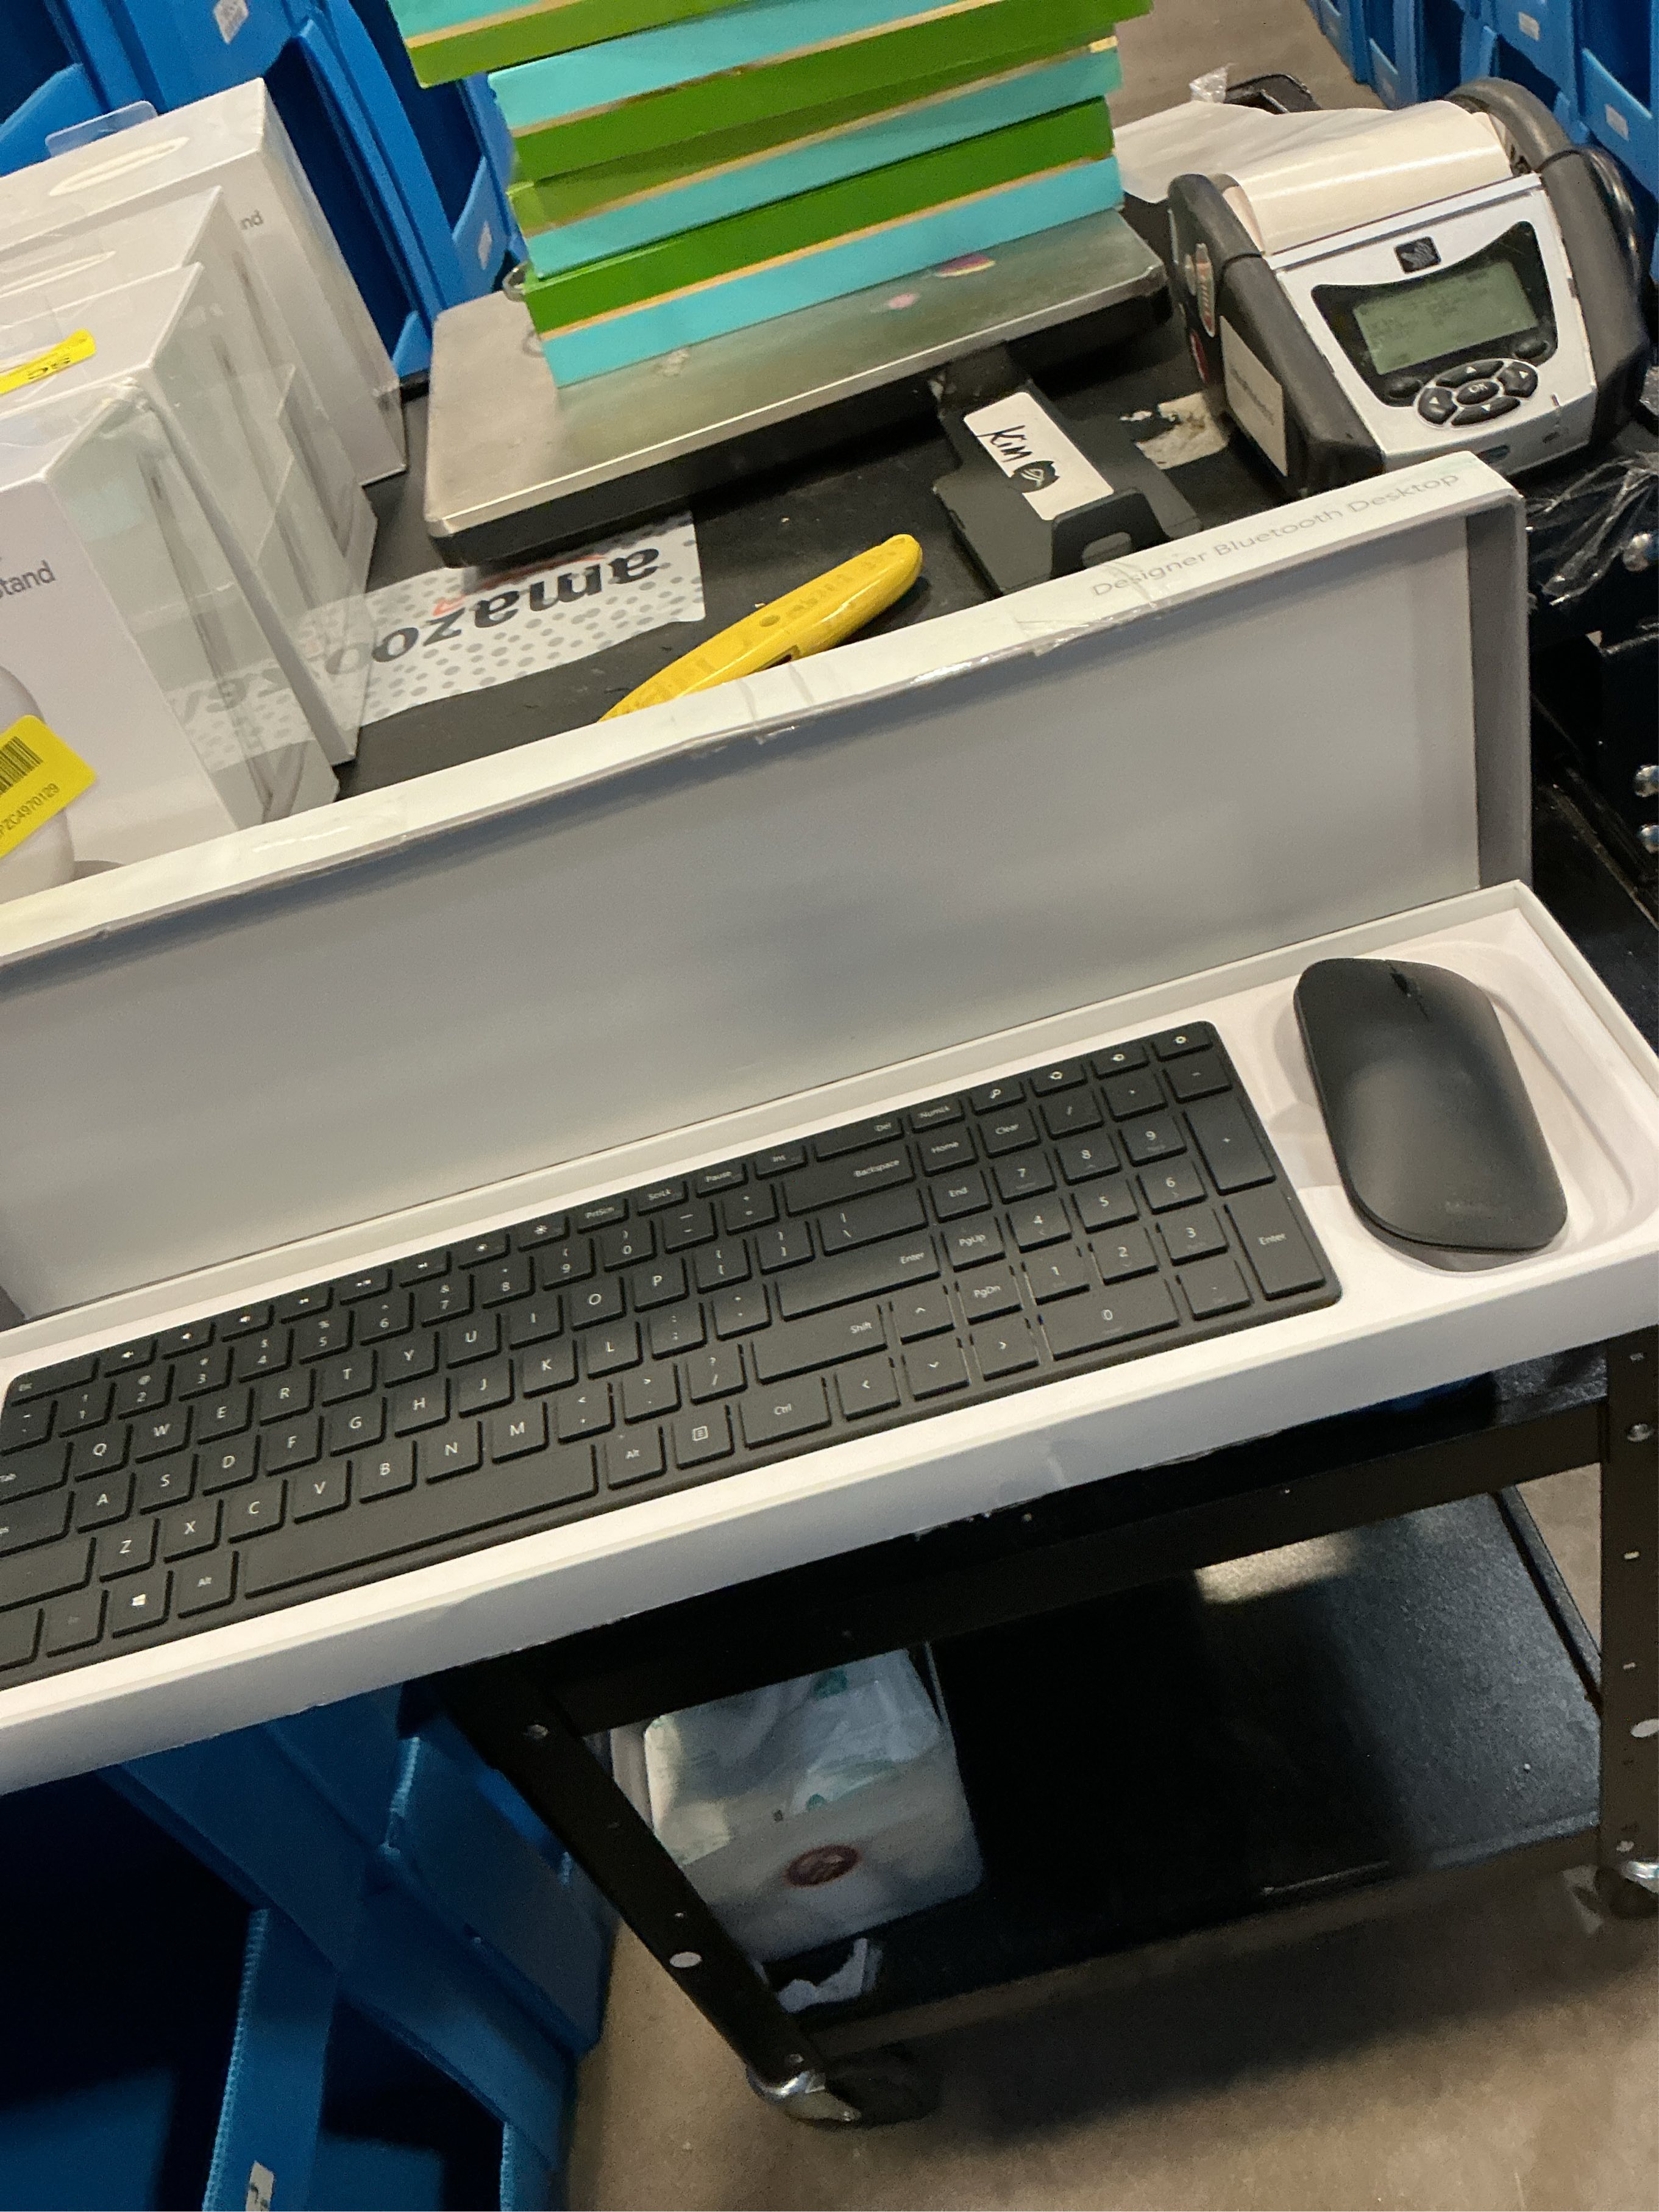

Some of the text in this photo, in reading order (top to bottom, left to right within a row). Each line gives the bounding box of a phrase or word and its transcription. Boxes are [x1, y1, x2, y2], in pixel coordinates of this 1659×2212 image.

[238, 209, 264, 230] nd
[1469, 383, 1488, 394] OK
[1090, 472, 1460, 597] Designer Bluetooth Desktop
[371, 546, 661, 664] amazo
[875, 1122, 892, 1132] Del
[995, 1124, 1018, 1135] Clear
[1145, 1131, 1156, 1140] 9
[931, 1142, 959, 1153] Home
[1081, 1150, 1092, 1159] 8
[853, 1160, 900, 1178] Backspace
[1017, 1168, 1026, 1178] 7
[705, 1170, 732, 1183] Pause
[1165, 1177, 1176, 1188] 6
[948, 1186, 968, 1198] End
[1099, 1196, 1109, 1207] 5
[1034, 1215, 1043, 1224] 4
[1186, 1227, 1196, 1239] 3
[1258, 1233, 1286, 1245] Enter
[959, 1234, 986, 1246] PgUp
[623, 1245, 632, 1255] 0
[1118, 1246, 1128, 1257] 2
[900, 1252, 925, 1264] Enter
[562, 1264, 571, 1273] 9
[1051, 1266, 1060, 1276] 1
[502, 1281, 511, 1292] 8
[653, 1275, 663, 1287] P
[973, 1286, 1001, 1298] PgDn
[588, 1293, 602, 1306] O
[1103, 1309, 1114, 1321] 0
[380, 1318, 389, 1328] 6
[850, 1321, 872, 1334] Shift
[319, 1336, 327, 1346] 5
[466, 1331, 477, 1343] U
[606, 1342, 615, 1353] L
[257, 1355, 267, 1364] 4
[403, 1350, 414, 1361] Y
[542, 1359, 552, 1371] K
[197, 1373, 206, 1384] 3
[343, 1368, 352, 1380] T
[711, 1374, 719, 1386] /
[480, 1378, 487, 1391] J
[137, 1392, 146, 1403] 2
[280, 1387, 290, 1399] R
[413, 1397, 425, 1410] H
[773, 1403, 792, 1415] Ctrl
[217, 1406, 227, 1419] E
[349, 1416, 362, 1429] G
[510, 1421, 525, 1436] M
[154, 1423, 170, 1437] W
[288, 1435, 297, 1448] F
[93, 1443, 107, 1456] Q
[445, 1442, 458, 1456] N
[625, 1449, 639, 1459] Alt
[222, 1455, 235, 1468] D
[380, 1462, 391, 1476] B
[161, 1474, 170, 1487] S
[314, 1481, 326, 1495] V
[96, 1493, 108, 1506] A
[249, 1501, 260, 1515] C
[184, 1520, 196, 1535] X
[119, 1539, 132, 1554] Z
